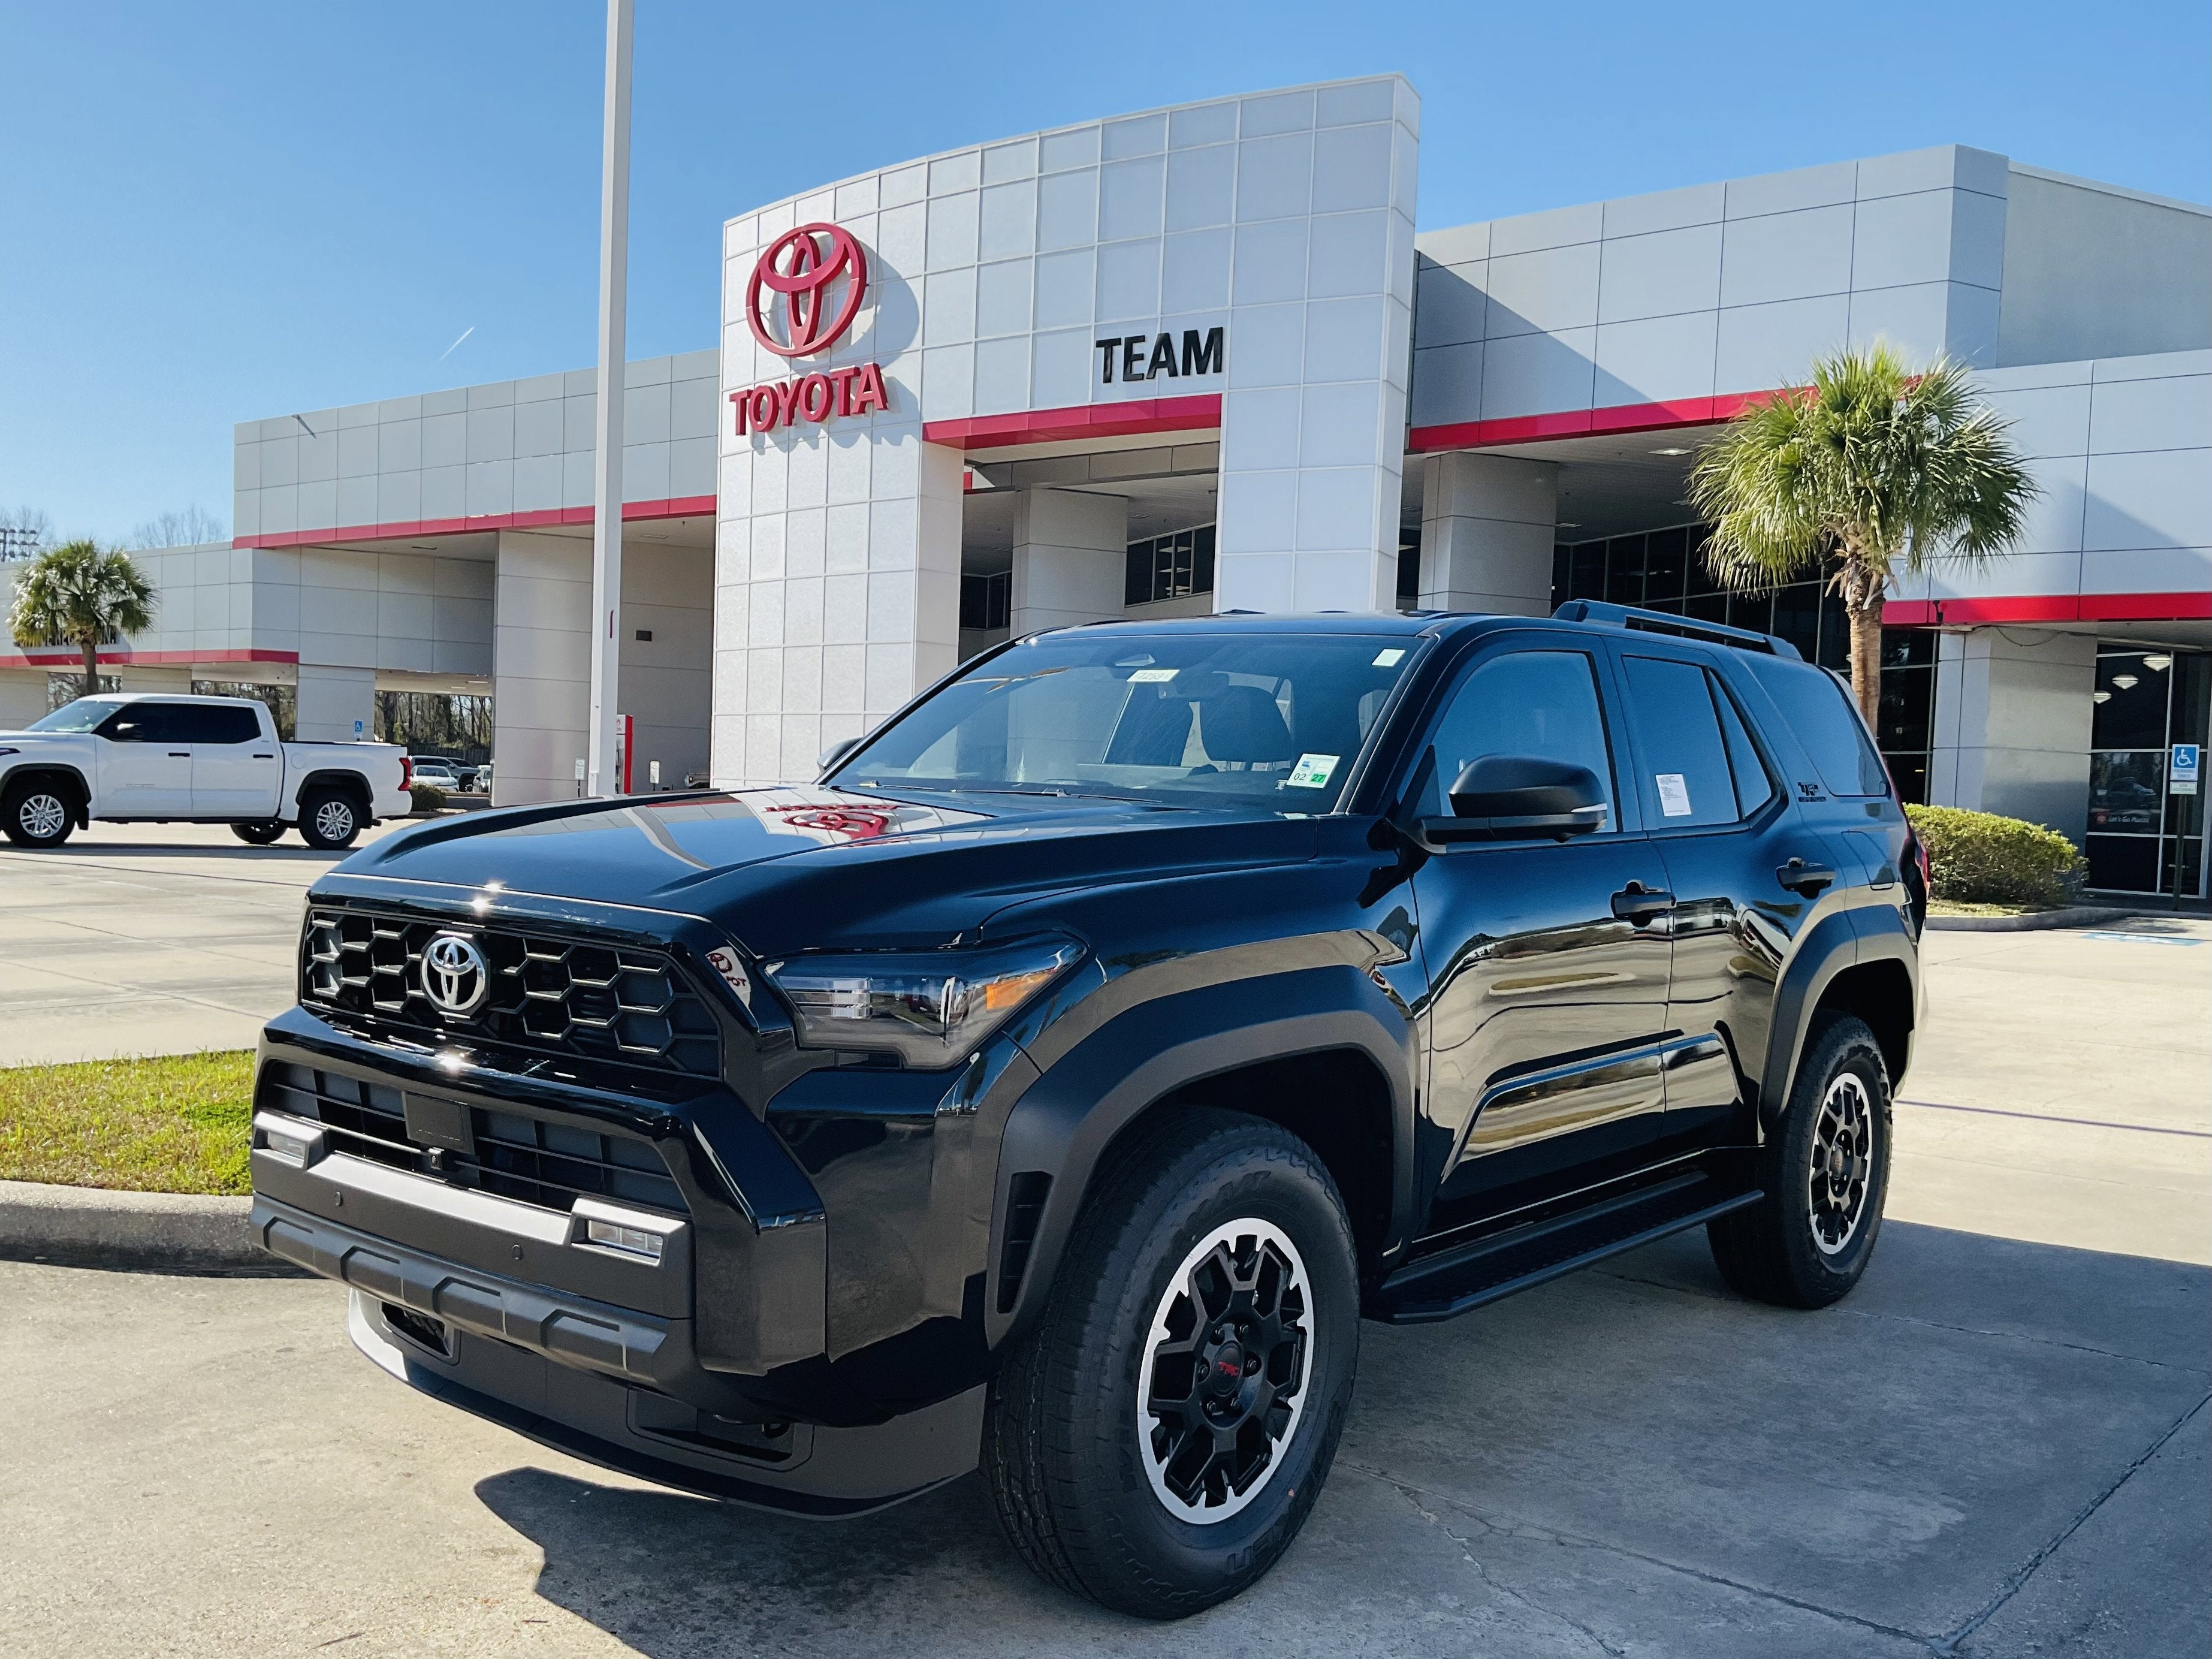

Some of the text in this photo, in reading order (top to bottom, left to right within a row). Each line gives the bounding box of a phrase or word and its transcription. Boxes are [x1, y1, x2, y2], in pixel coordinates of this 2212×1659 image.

[1096, 327, 1223, 384] TEAM
[729, 361, 888, 436] TOYOTA
[1311, 774, 1326, 782] 27
